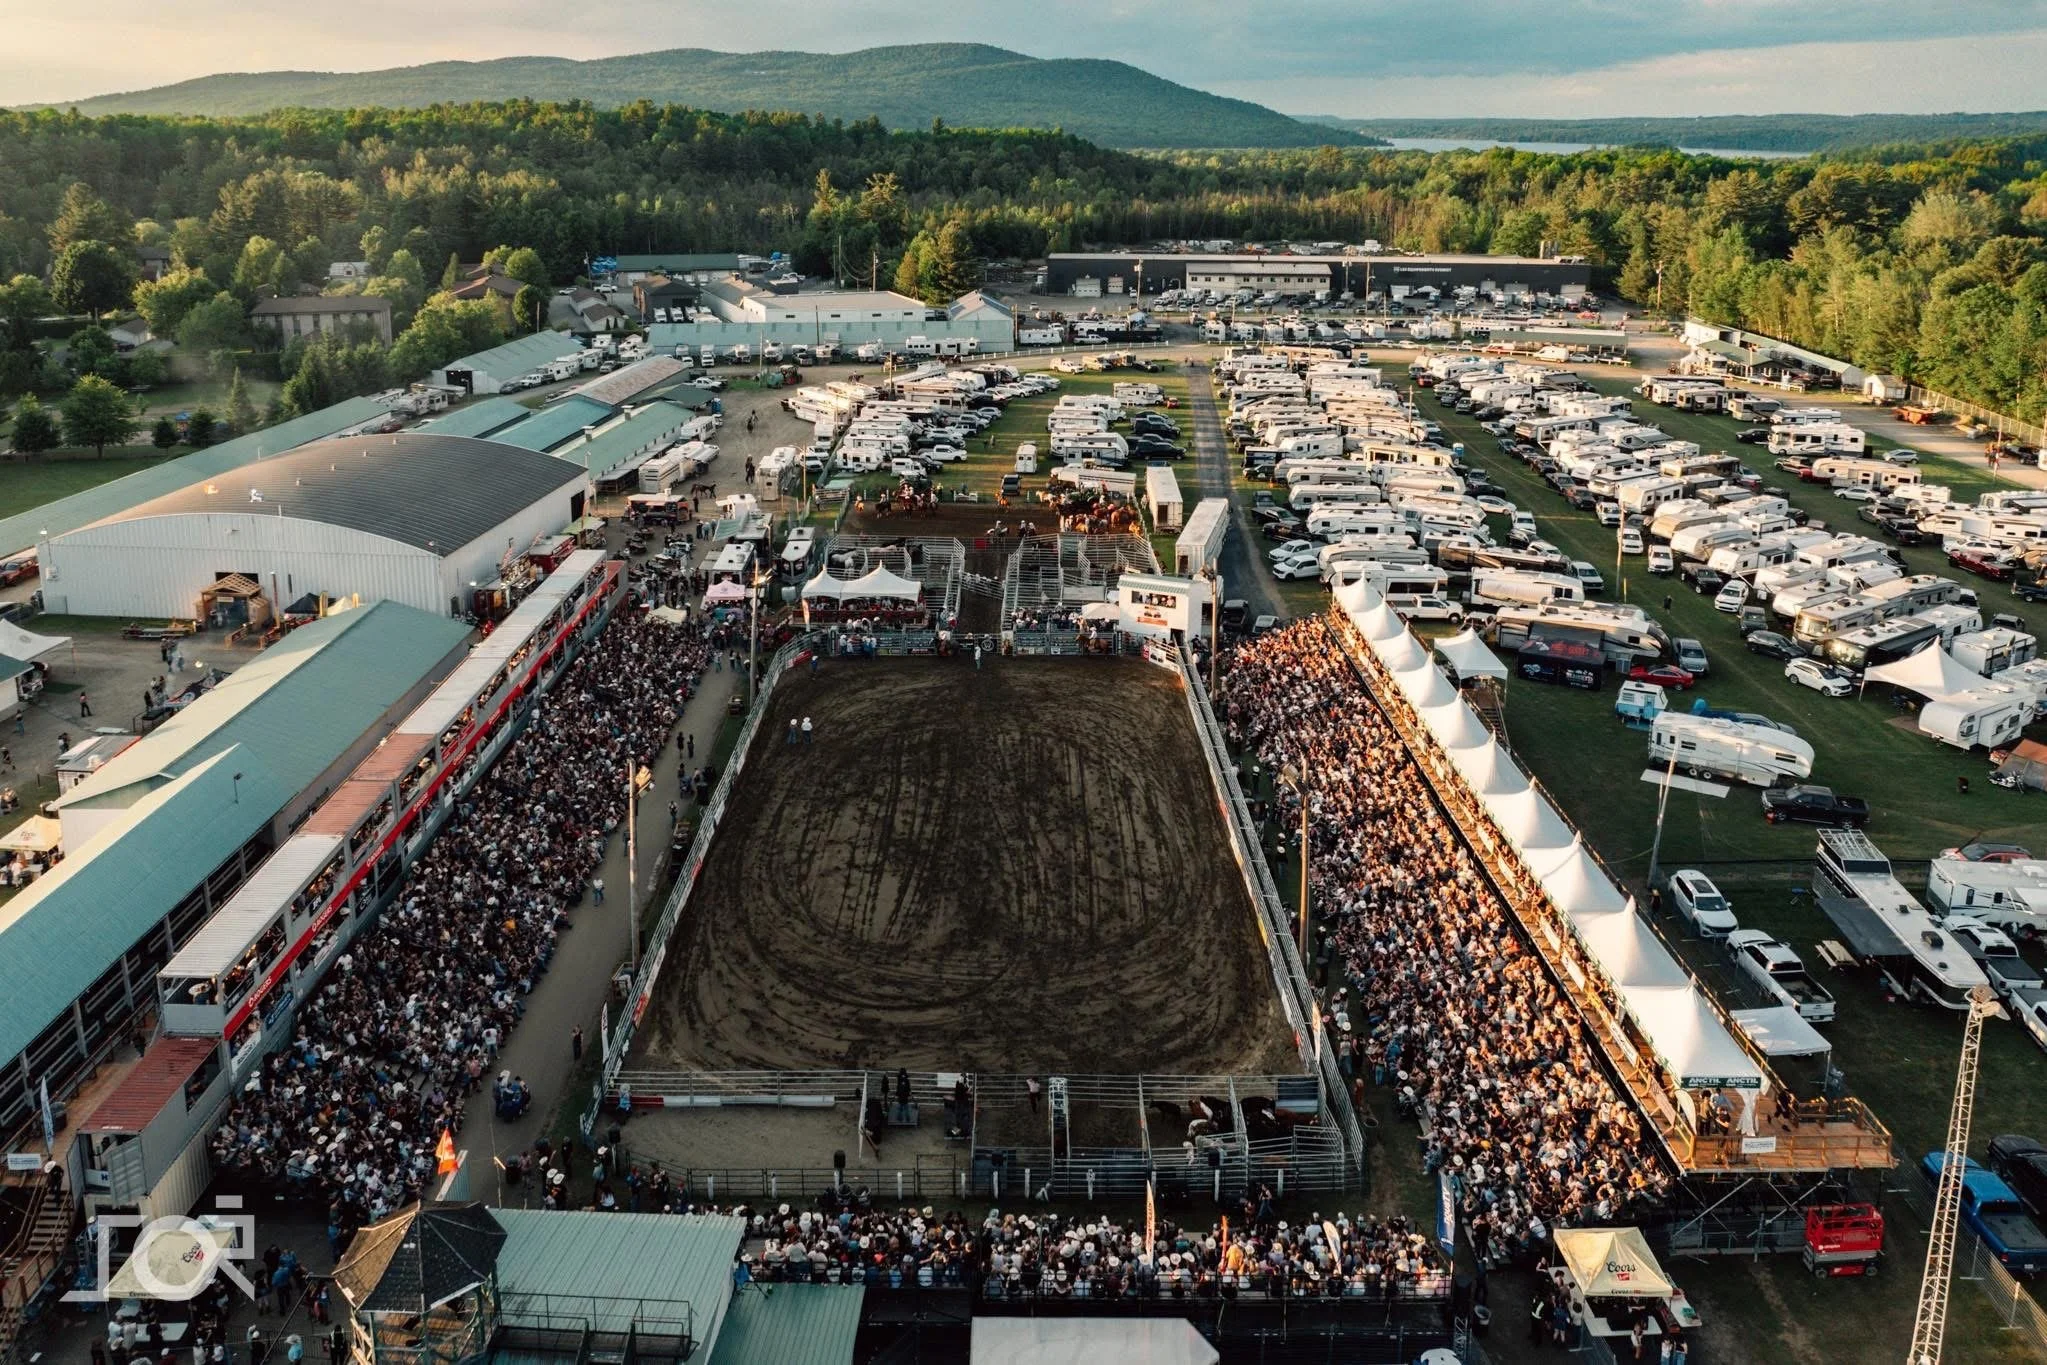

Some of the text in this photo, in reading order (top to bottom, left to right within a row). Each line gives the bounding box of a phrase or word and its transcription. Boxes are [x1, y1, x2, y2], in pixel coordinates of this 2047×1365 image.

[255, 975, 272, 1000] ROGERS
[182, 1242, 203, 1263] Coors
[1606, 1261, 1637, 1273] Coors
